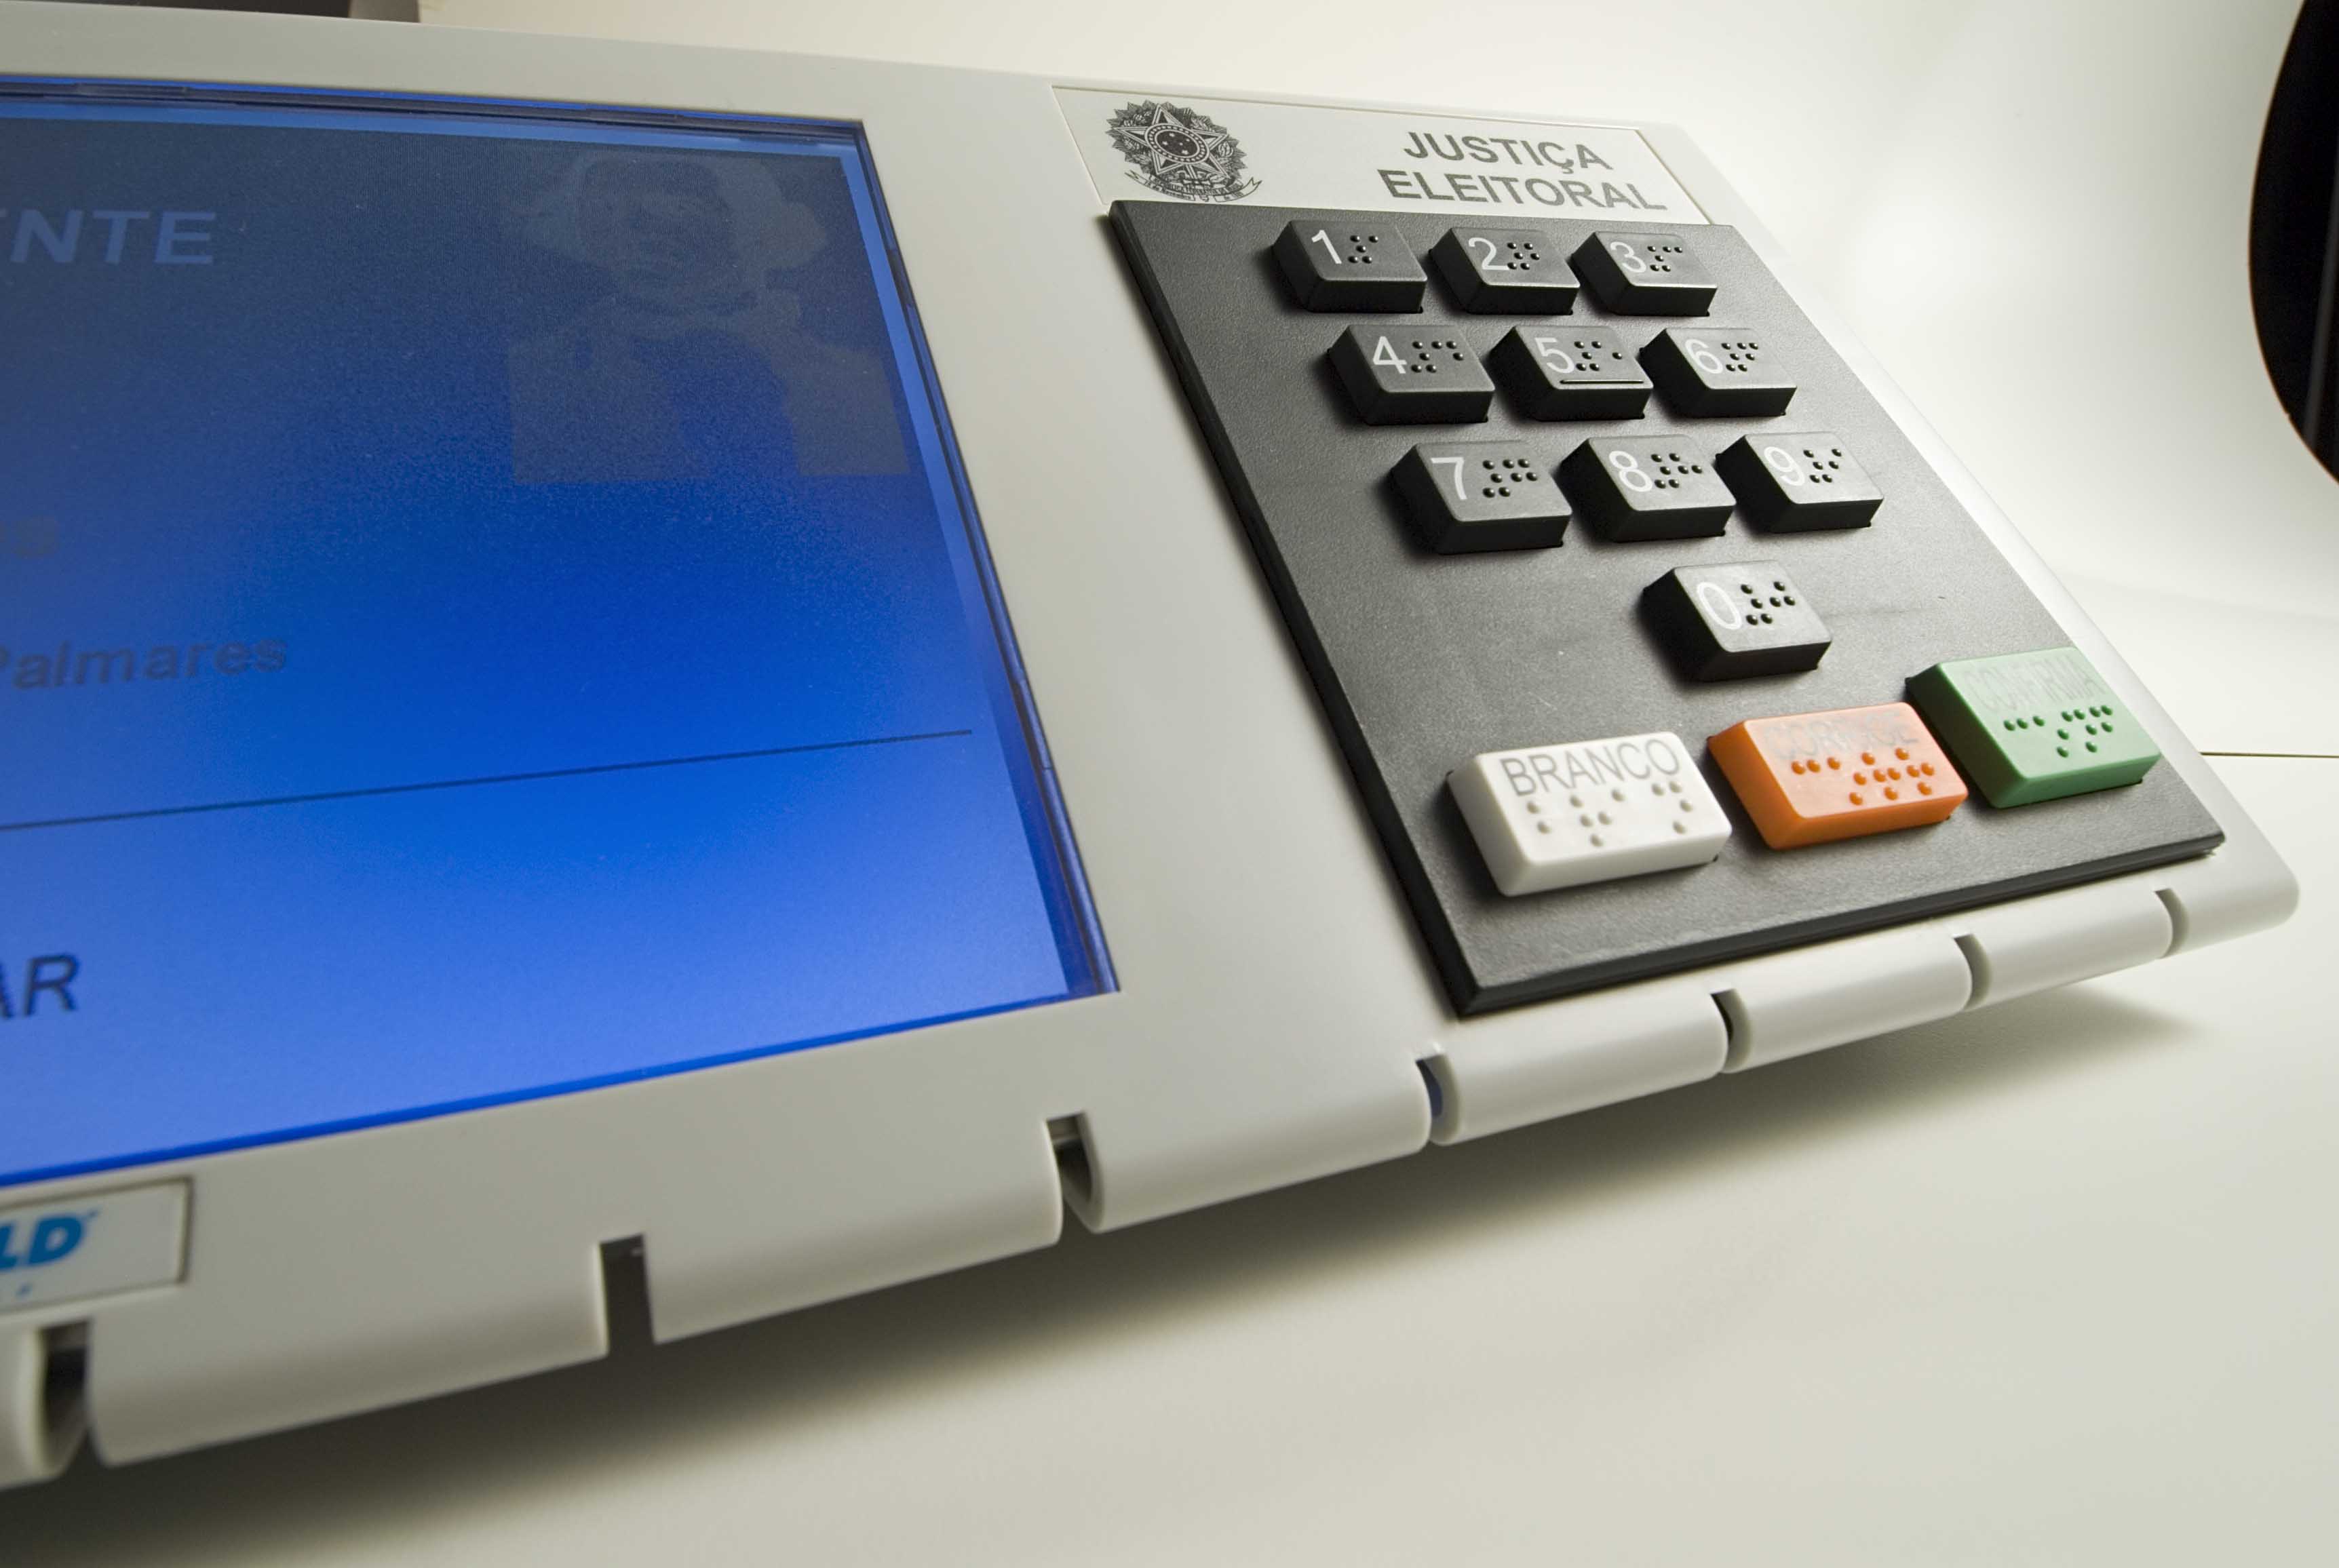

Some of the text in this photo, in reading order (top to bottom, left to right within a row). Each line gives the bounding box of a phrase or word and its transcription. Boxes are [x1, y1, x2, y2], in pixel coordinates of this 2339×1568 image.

[1404, 132, 1614, 174] JUSTIÇA
[1377, 170, 1668, 210] ELEITORAL
[0, 209, 217, 264] NTE
[1311, 229, 1342, 264] 1
[1467, 237, 1509, 271] 2
[1610, 241, 1648, 273] 3
[1372, 336, 1408, 374] 4
[1534, 337, 1575, 374] 5
[1684, 338, 1724, 374] 6
[1429, 456, 1468, 501] 7
[1608, 450, 1654, 492] 8
[1764, 446, 1805, 486] 9
[1695, 581, 1743, 630] 0
[1499, 739, 1680, 796] BRANCO
